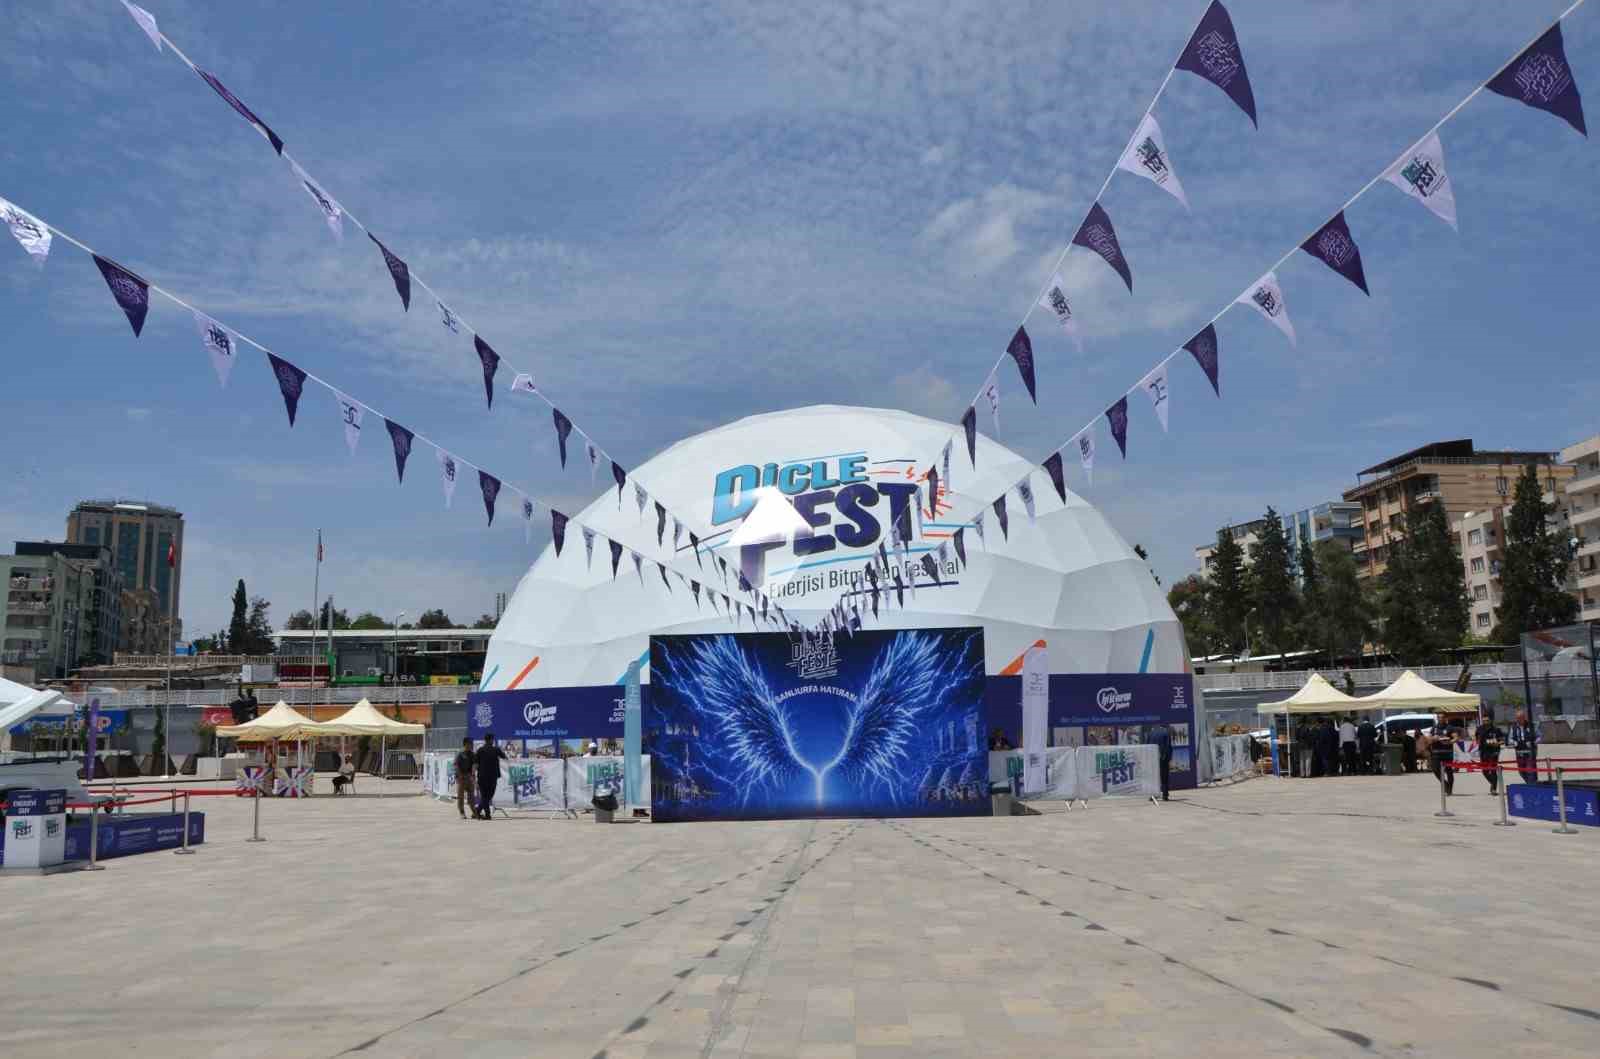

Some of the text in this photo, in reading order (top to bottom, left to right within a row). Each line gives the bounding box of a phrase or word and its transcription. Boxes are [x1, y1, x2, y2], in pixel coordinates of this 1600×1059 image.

[769, 556, 960, 599] Enerjisi Bitmen Fesial
[1102, 761, 1136, 793] FEST
